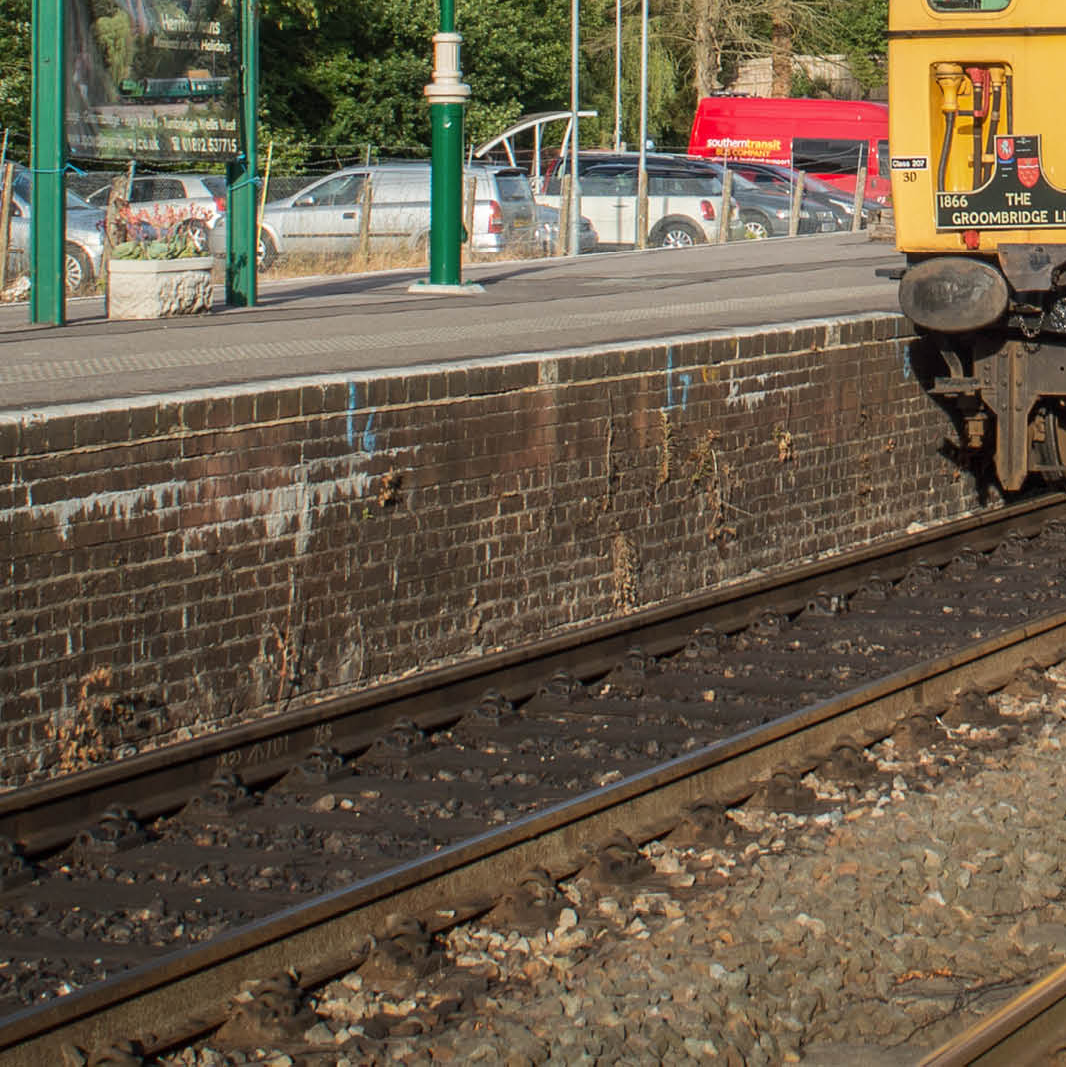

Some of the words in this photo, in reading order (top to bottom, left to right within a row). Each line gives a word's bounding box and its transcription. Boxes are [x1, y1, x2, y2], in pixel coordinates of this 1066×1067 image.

[200, 38, 232, 55] Holidays
[198, 117, 219, 131] Wells
[220, 118, 237, 131] West
[208, 137, 237, 153] 537715
[733, 148, 771, 158] COMPANY
[891, 159, 911, 168] Class
[912, 159, 925, 168] 207
[939, 194, 968, 208] 1866
[1005, 192, 1031, 206] THE
[952, 210, 1048, 225] GROOMBRIDGE
